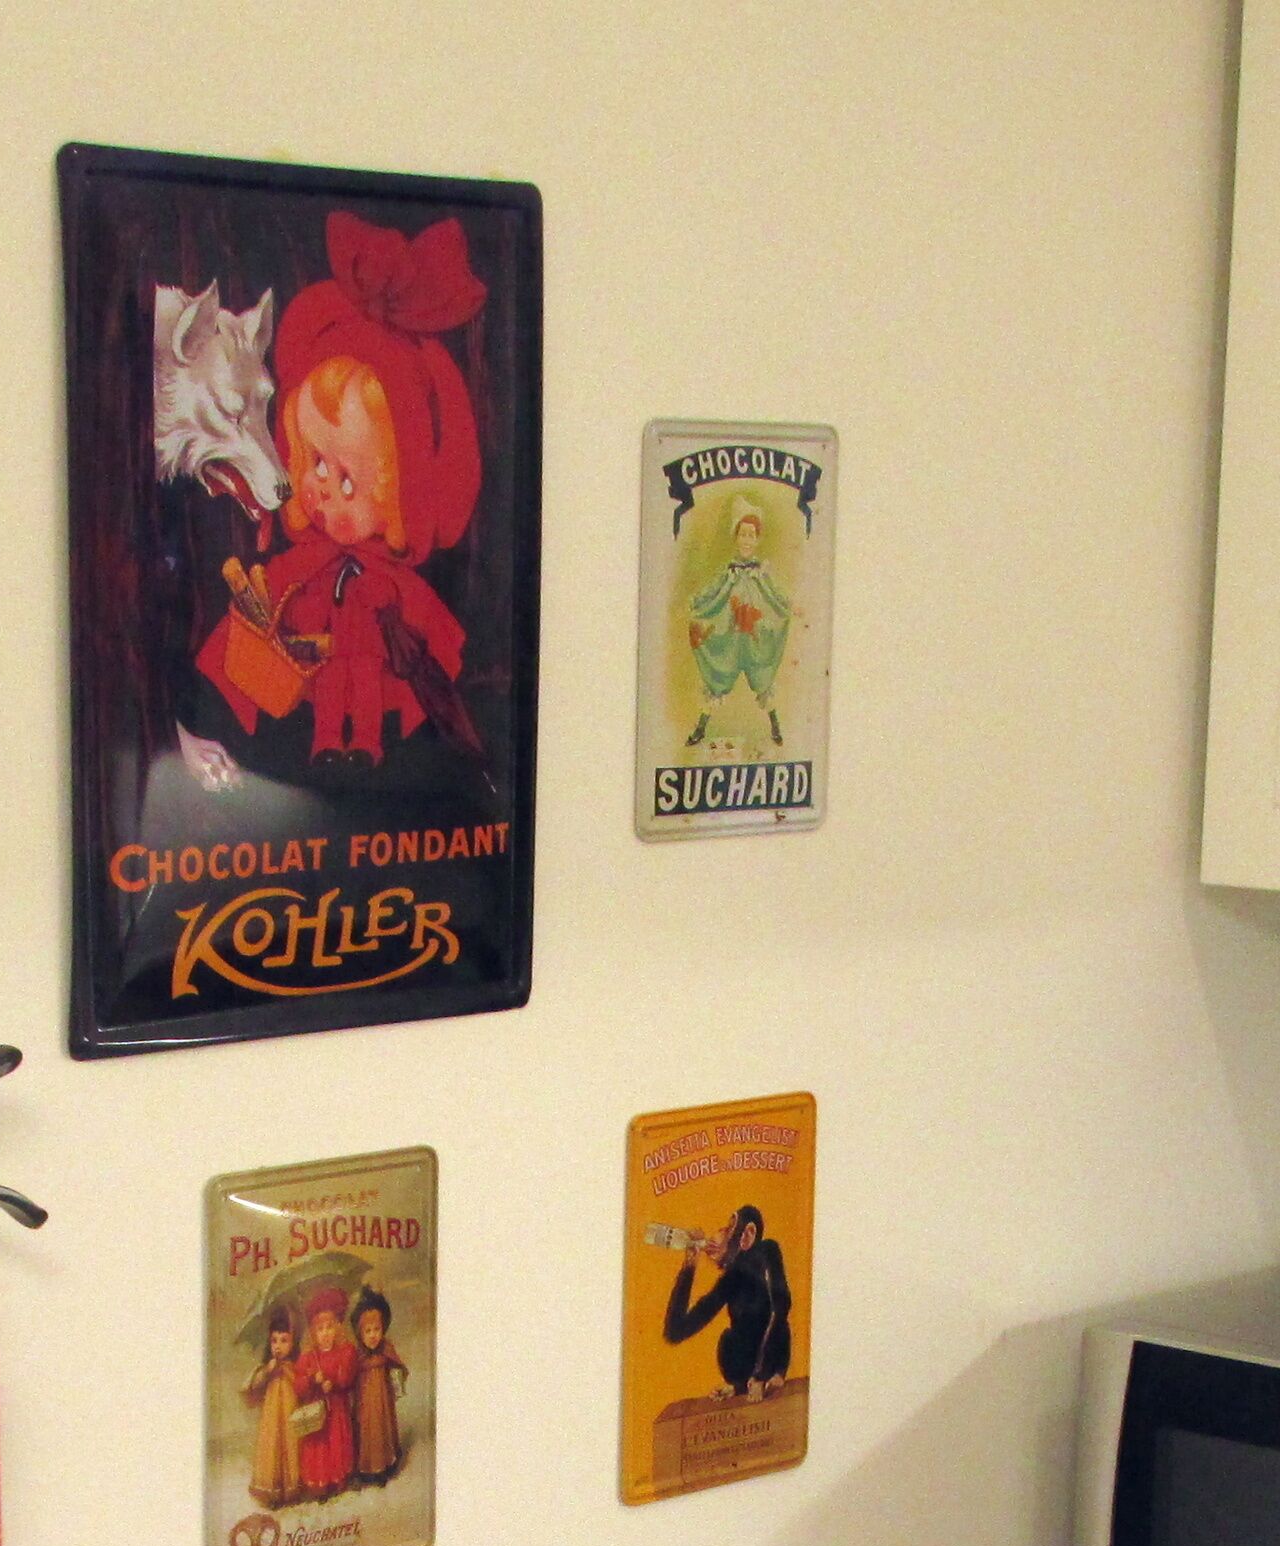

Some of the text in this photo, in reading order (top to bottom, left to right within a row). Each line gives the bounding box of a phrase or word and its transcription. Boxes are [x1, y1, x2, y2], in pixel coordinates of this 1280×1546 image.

[681, 447, 813, 487] CHOCOLAT
[657, 763, 809, 812] SUCHARD
[109, 822, 510, 893] CHOCOLAT FONDANT
[171, 887, 461, 1000] KOHLER
[643, 1129, 712, 1175] ANISETTA
[651, 1153, 720, 1197] LIQUORE
[733, 1151, 794, 1175] DESSERT
[228, 1214, 421, 1277] PH. SUCHARD
